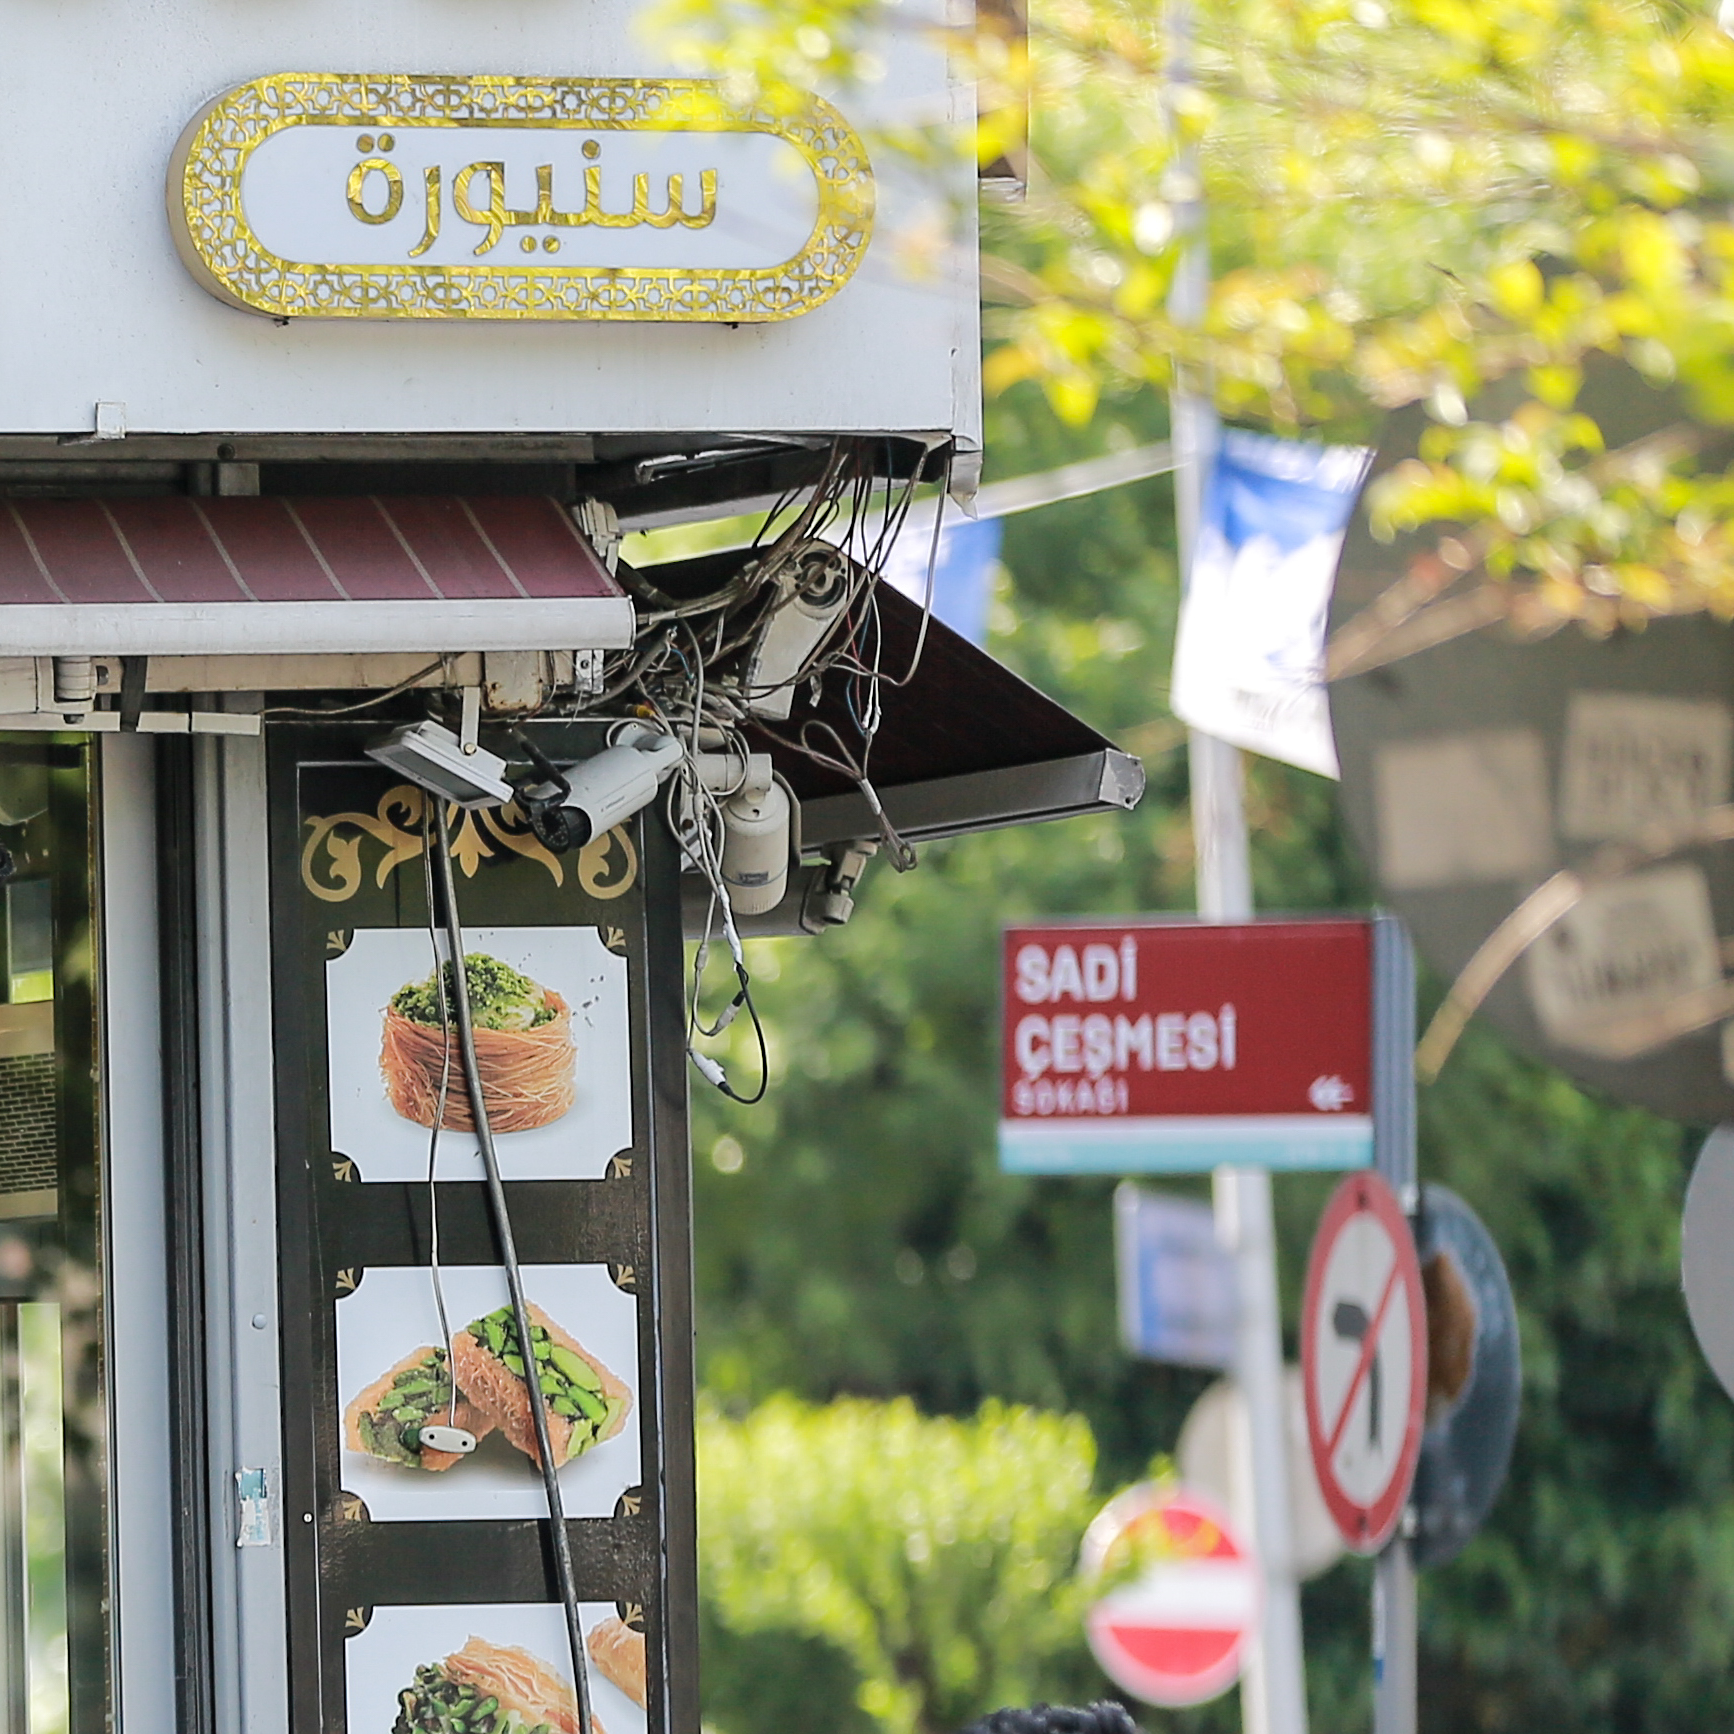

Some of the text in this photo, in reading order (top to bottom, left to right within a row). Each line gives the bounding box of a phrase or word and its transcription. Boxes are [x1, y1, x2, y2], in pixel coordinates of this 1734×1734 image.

[345, 133, 719, 257] سنيورة
[1016, 935, 1137, 1003] SADİ
[1015, 1002, 1236, 1081] ÇEŞMESİ
